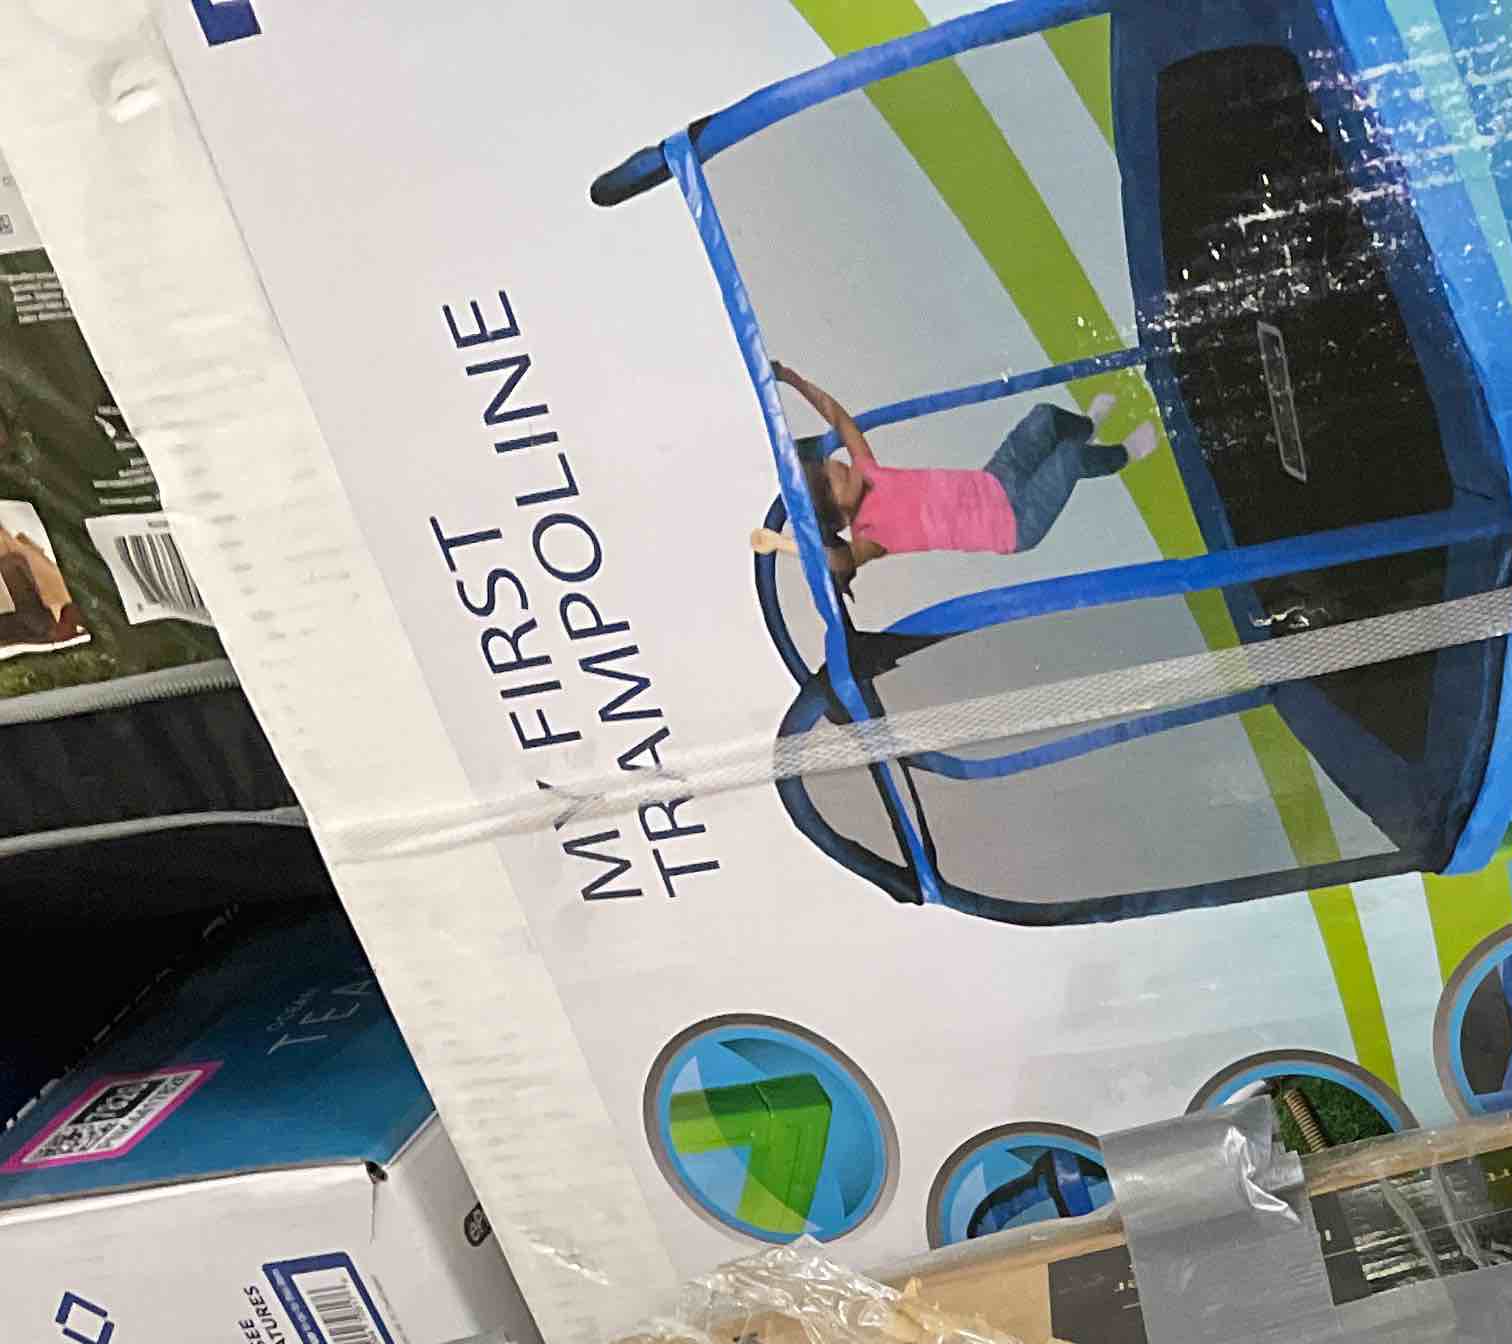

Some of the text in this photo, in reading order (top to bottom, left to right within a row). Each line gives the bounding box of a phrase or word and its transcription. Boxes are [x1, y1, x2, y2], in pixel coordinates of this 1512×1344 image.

[430, 516, 643, 901] MY FIRST
[443, 290, 721, 898] TRAMPOLINE
